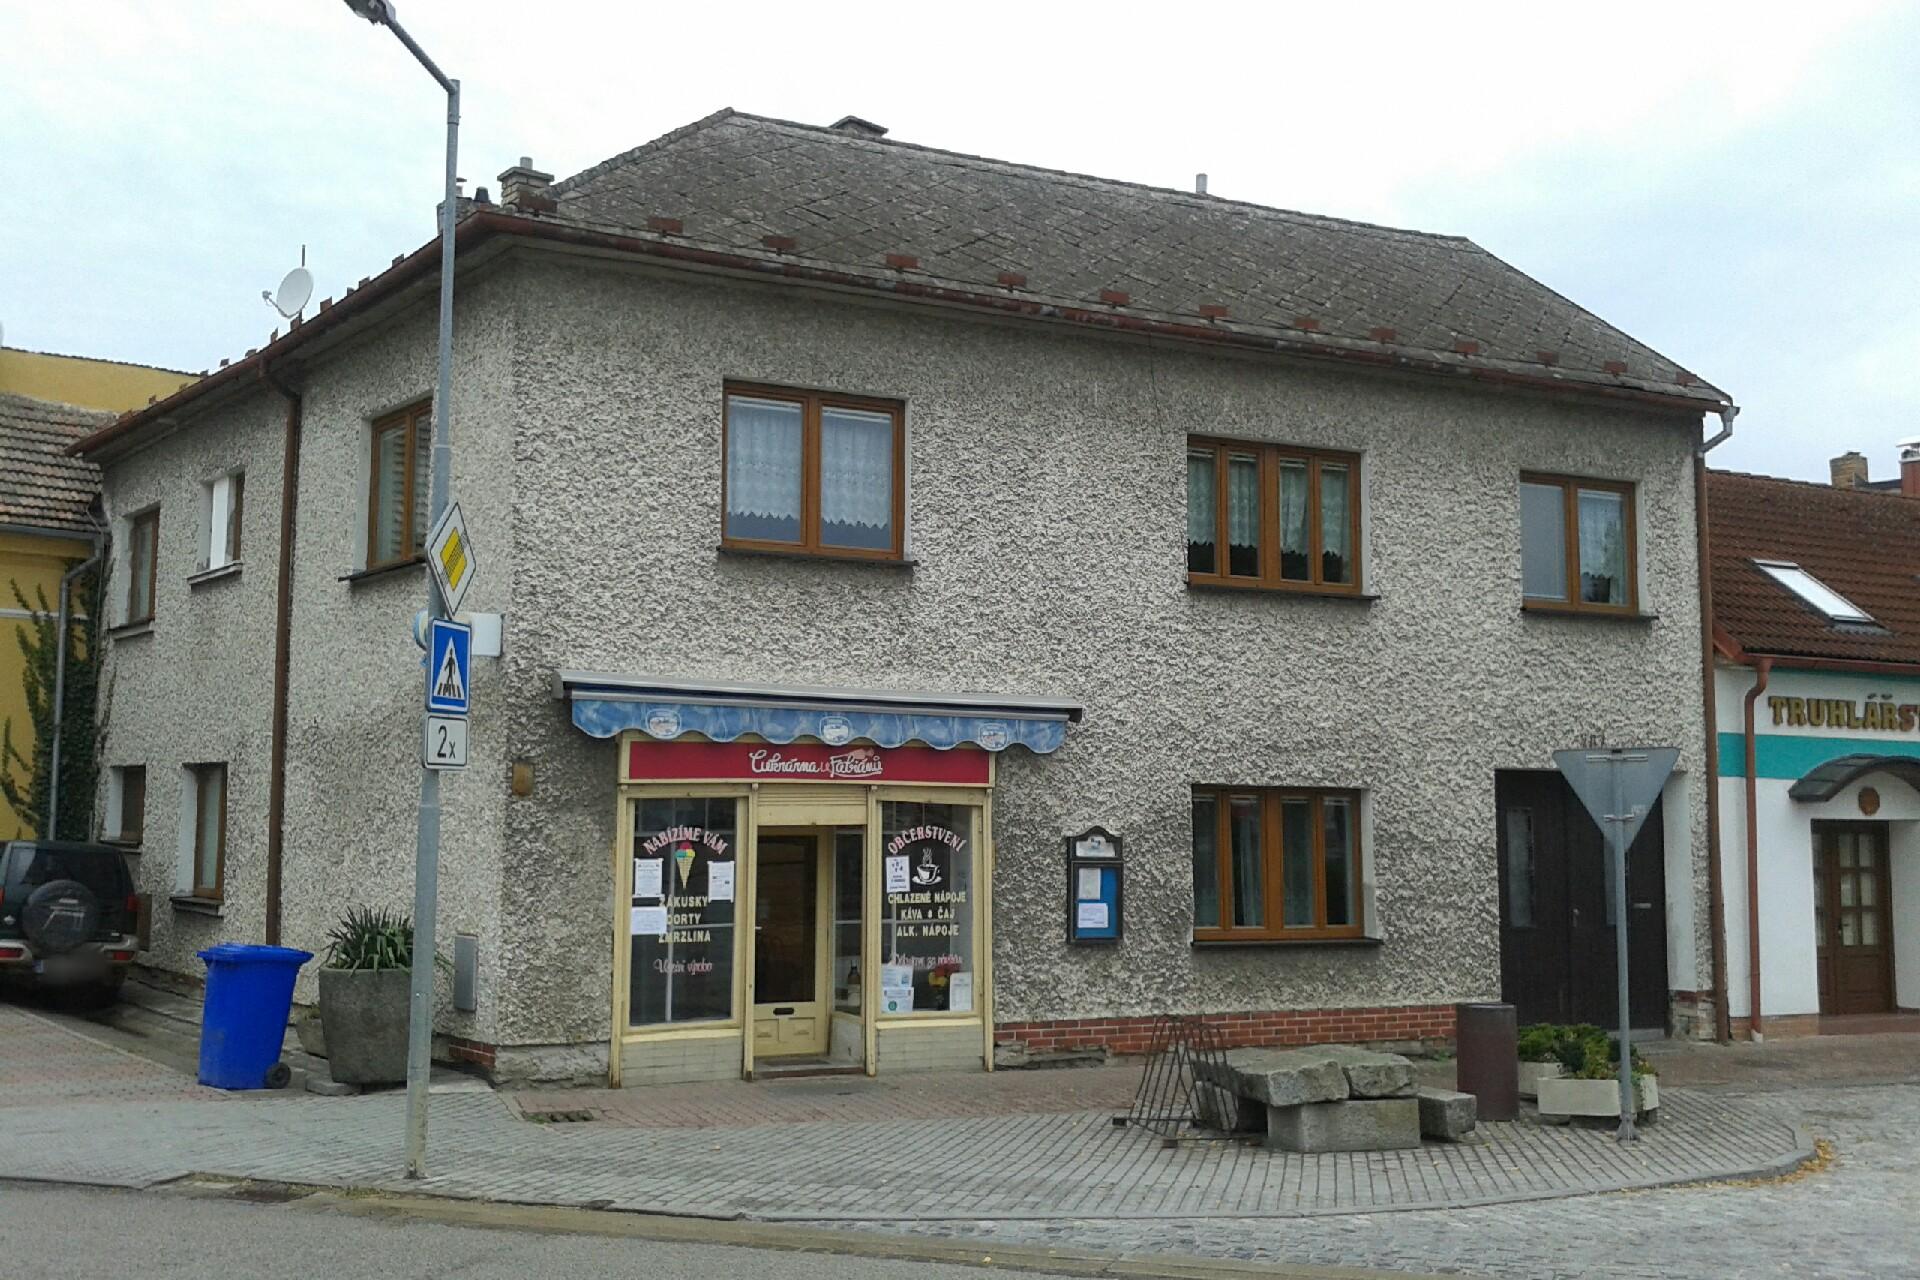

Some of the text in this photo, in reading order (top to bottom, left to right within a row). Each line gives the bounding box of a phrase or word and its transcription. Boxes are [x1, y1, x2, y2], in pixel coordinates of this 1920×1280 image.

[1768, 694, 1920, 731] TRUHLÁŘS
[437, 725, 456, 759] 2x
[748, 749, 821, 774] Cukrárna
[643, 825, 729, 855] NABÍZÍME VÁM
[888, 825, 966, 855] OBČERSTVENÍ
[659, 894, 708, 908] ZÁKUSKY
[887, 890, 966, 904] CHLAZENÉ NÁPOJE
[900, 906, 923, 920] KÁVA
[937, 906, 956, 920] ČAJ
[658, 929, 711, 943] ZMRZLINA
[896, 923, 960, 937] ALK. NÁPOJE
